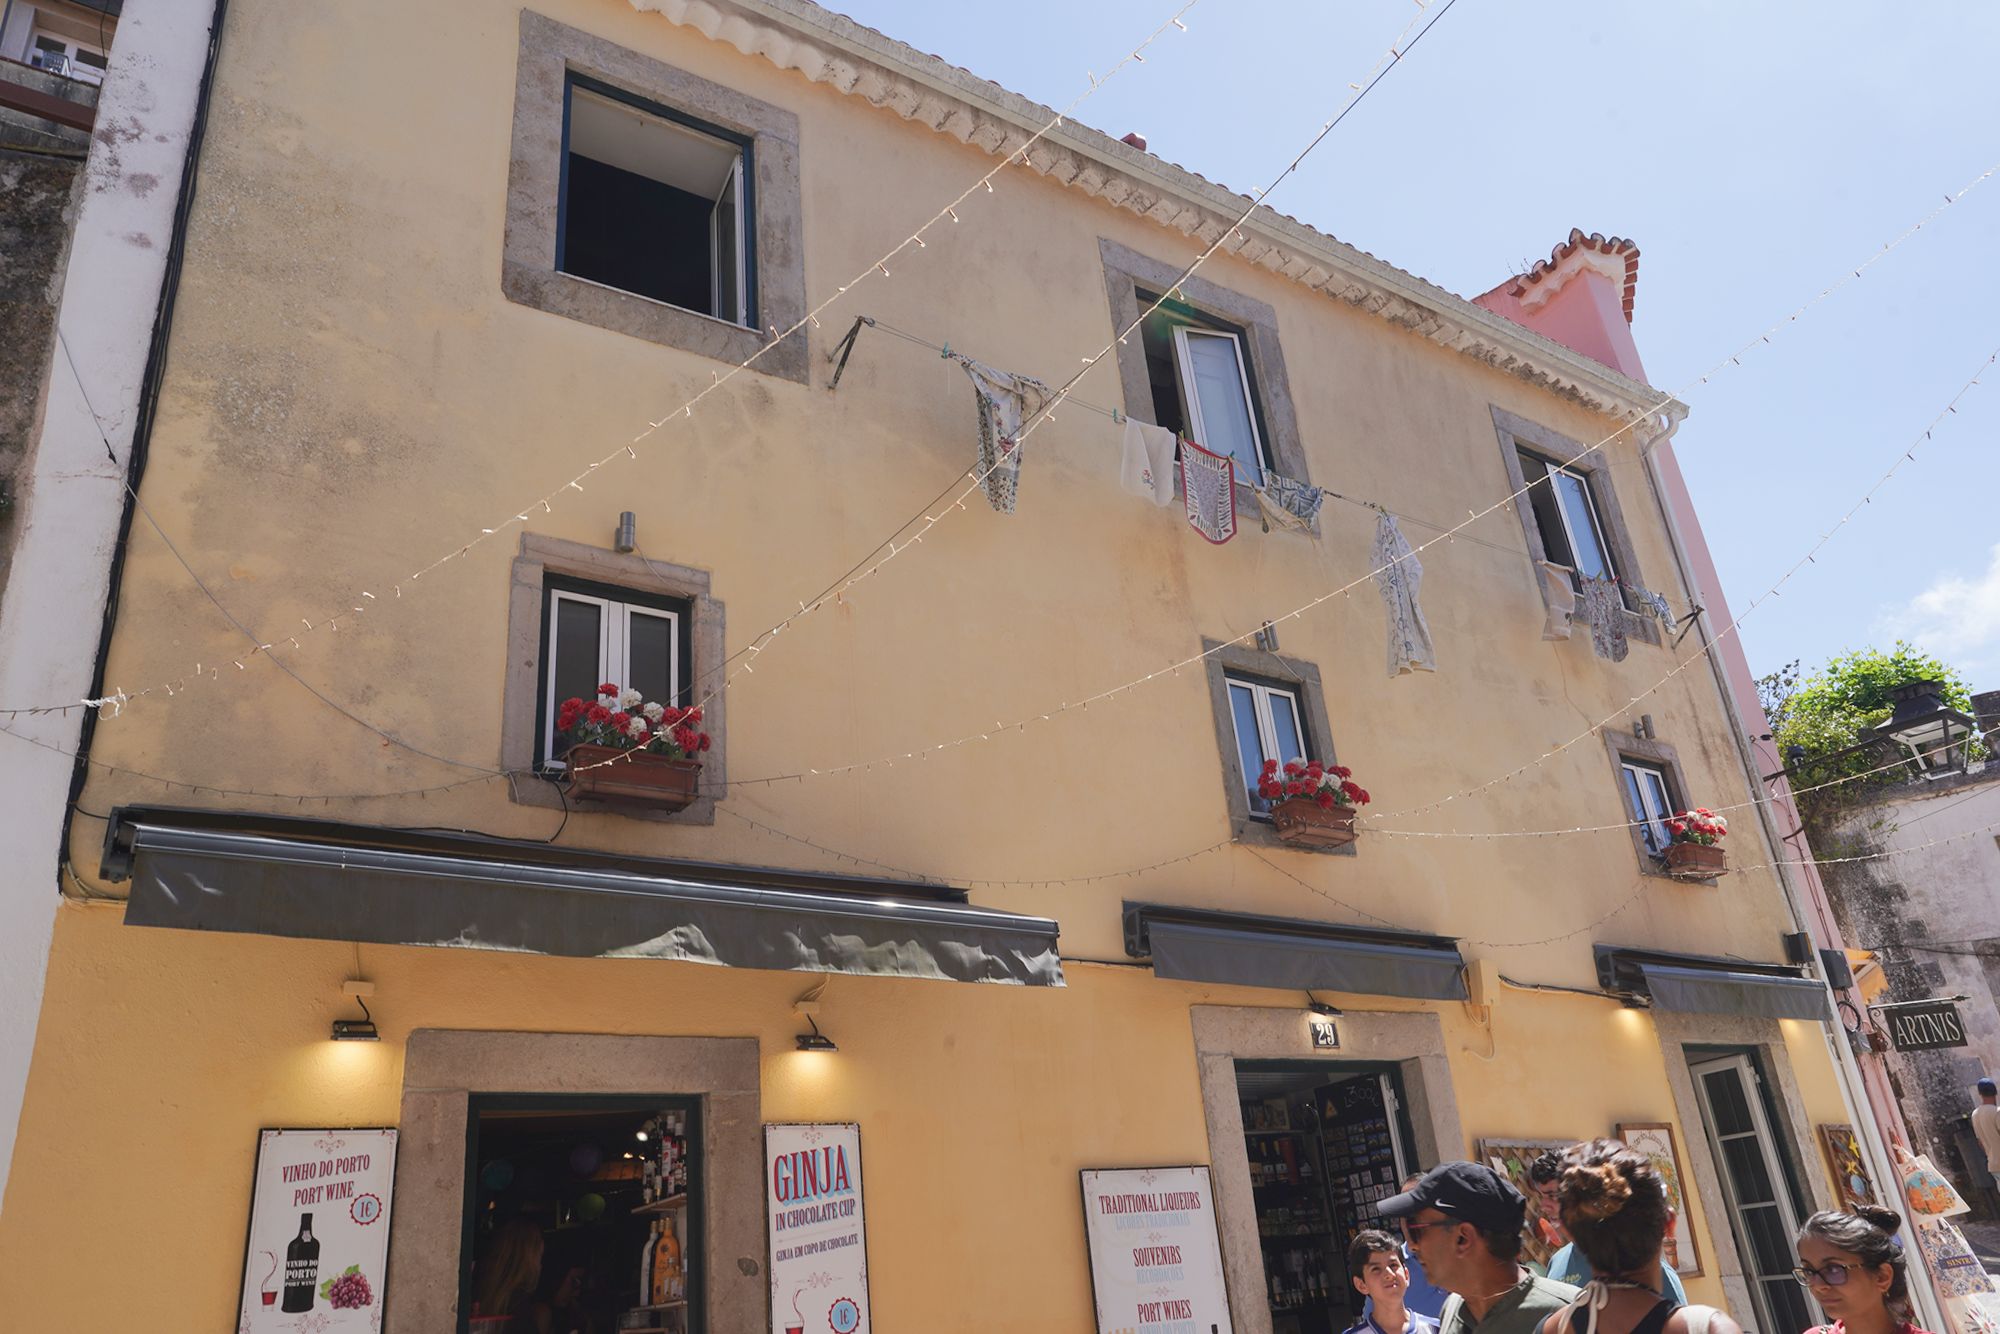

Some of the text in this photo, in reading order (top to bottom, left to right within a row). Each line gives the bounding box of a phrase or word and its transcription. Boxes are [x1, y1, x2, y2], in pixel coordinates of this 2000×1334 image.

[1315, 1023, 1335, 1045] 29
[1895, 1011, 1961, 1046] ARTNIS
[282, 1154, 370, 1183] VINHO DO PORTO
[773, 1144, 852, 1203] GINJA
[293, 1180, 355, 1207] PORT WINE
[1099, 1191, 1202, 1215] TRADITIONAL LIQUEURS
[360, 1201, 373, 1218] 1€
[775, 1198, 856, 1232] IN CHOCOLATE CUP
[776, 1233, 858, 1262] GINJA EM COPO DE CHOCOLATE
[1132, 1245, 1182, 1267] SOUVENIRS
[285, 1268, 317, 1280] PORTO
[286, 1259, 318, 1268] VINHO DO
[839, 1308, 850, 1326] 1€
[1137, 1299, 1193, 1324] PORT WINES
